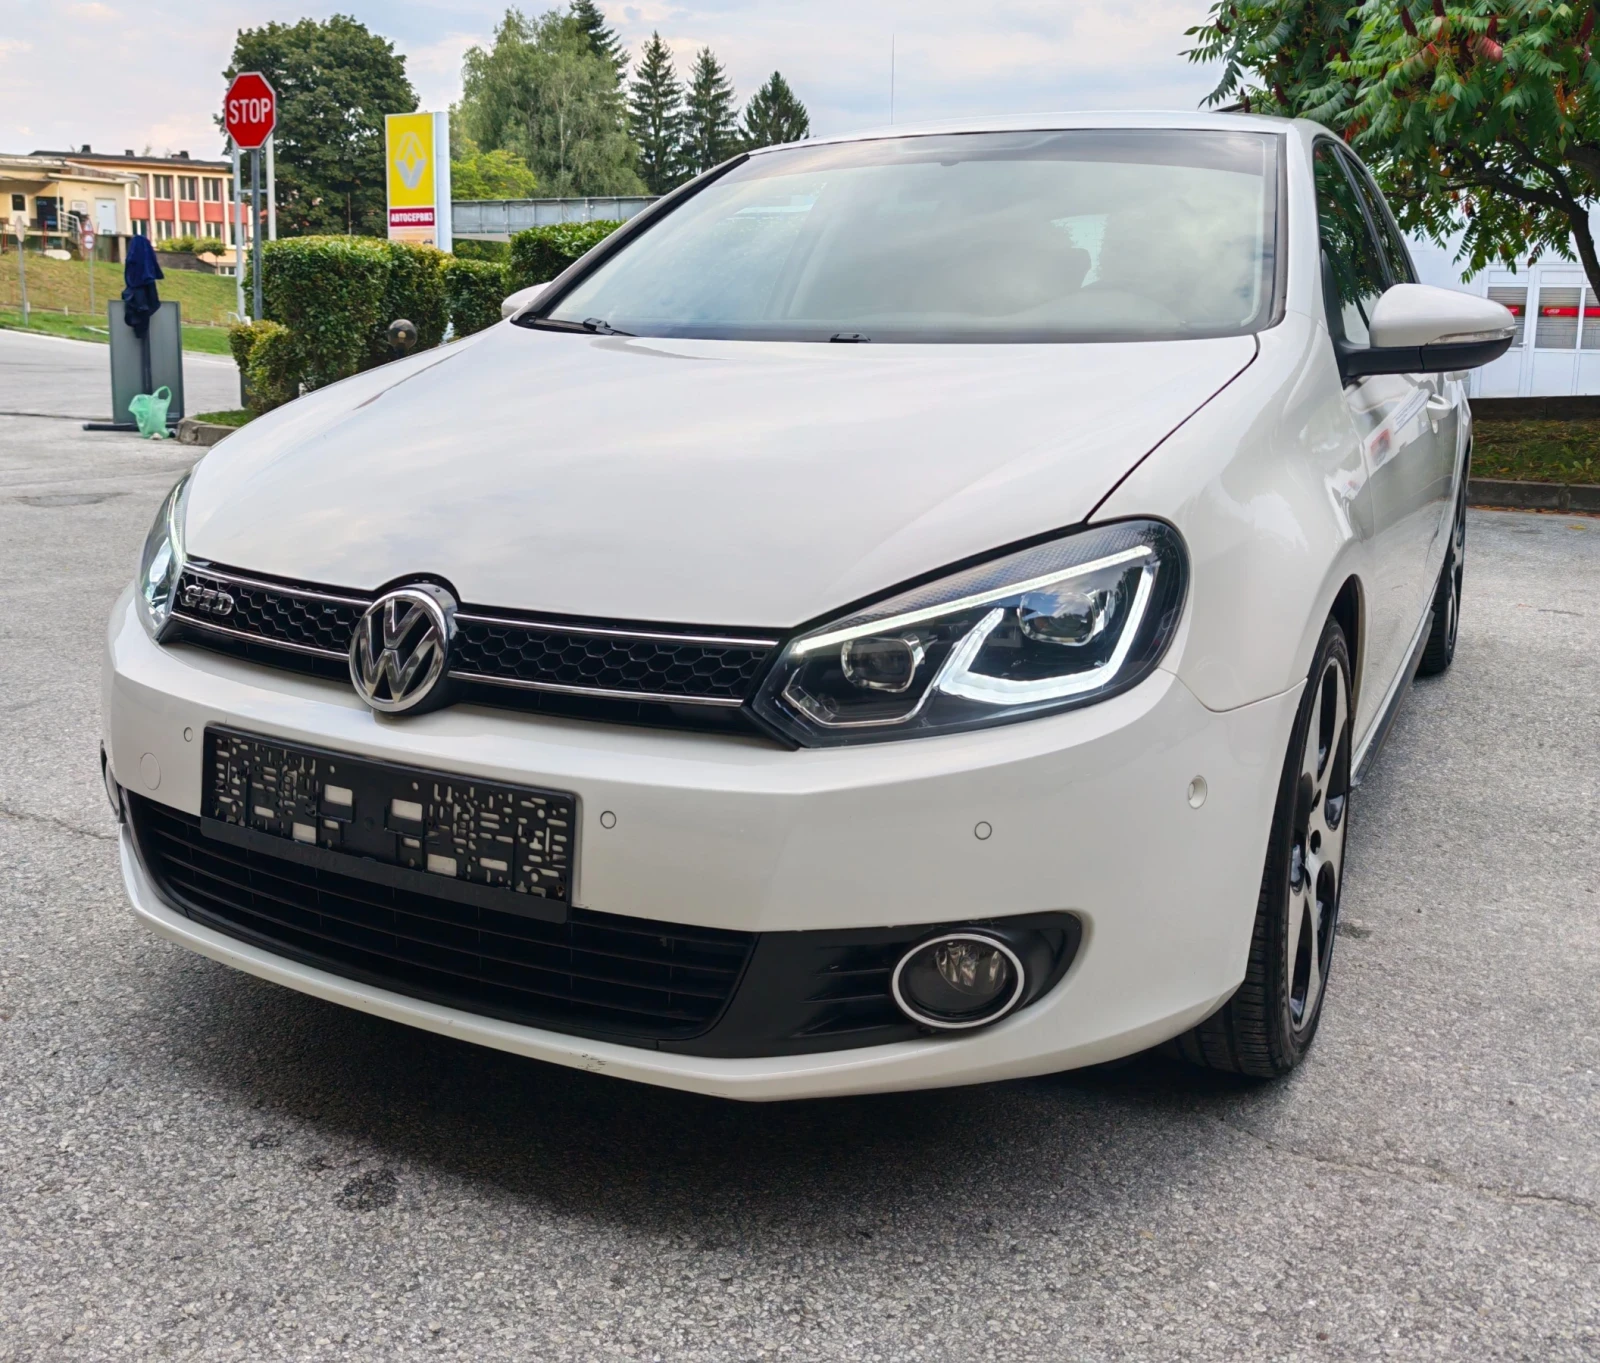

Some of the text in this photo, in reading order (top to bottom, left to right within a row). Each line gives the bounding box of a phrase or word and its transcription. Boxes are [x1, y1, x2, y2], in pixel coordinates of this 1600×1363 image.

[229, 98, 271, 124] STOP
[391, 212, 433, 222] АВТОСЕРВИЗ
[185, 585, 234, 615] GTD
